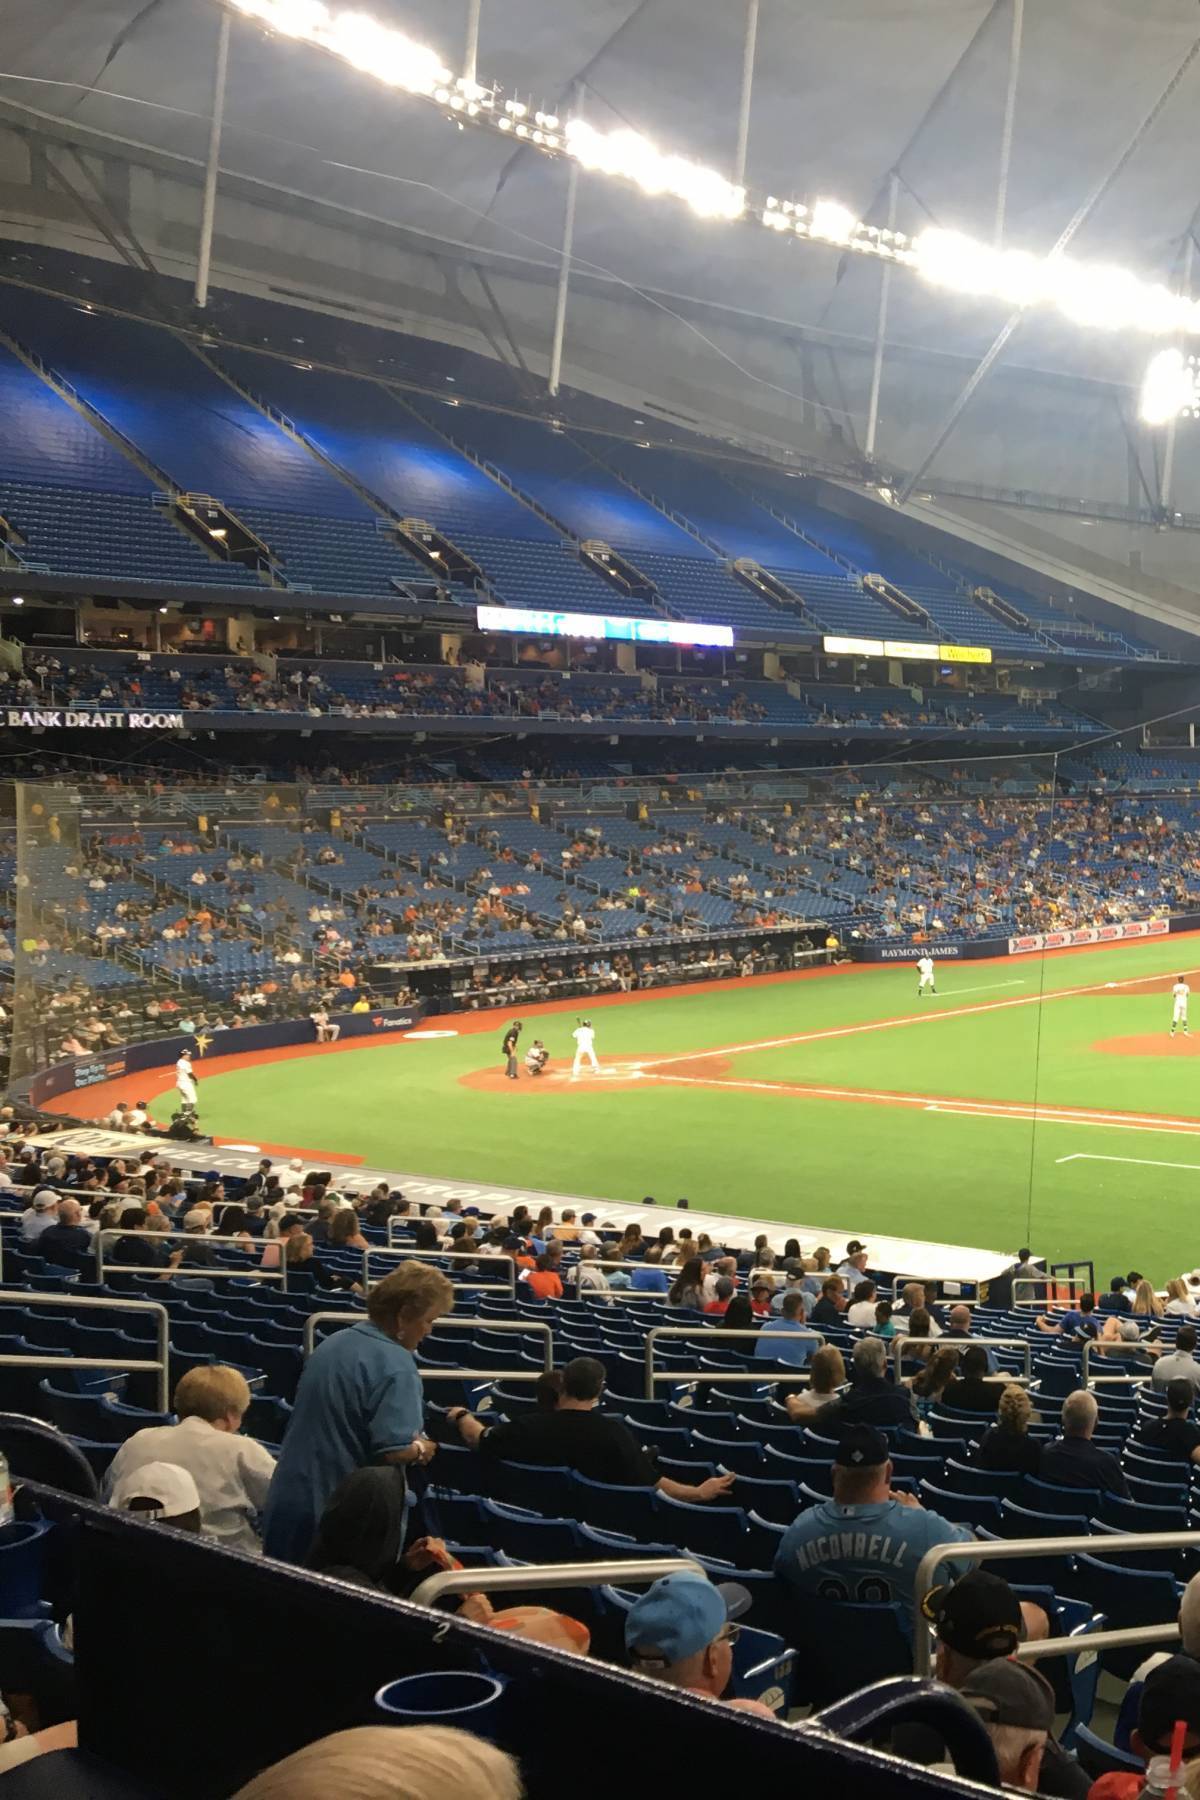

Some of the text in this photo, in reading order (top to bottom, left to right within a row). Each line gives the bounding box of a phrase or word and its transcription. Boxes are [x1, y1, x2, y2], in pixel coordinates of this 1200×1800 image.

[8, 711, 61, 727] BANK
[65, 712, 125, 728] DRAFT
[128, 713, 184, 729] ROOM
[881, 946, 959, 957] RAYMOND JAMES
[383, 1017, 412, 1027] Fanatics
[337, 1173, 387, 1186] TO
